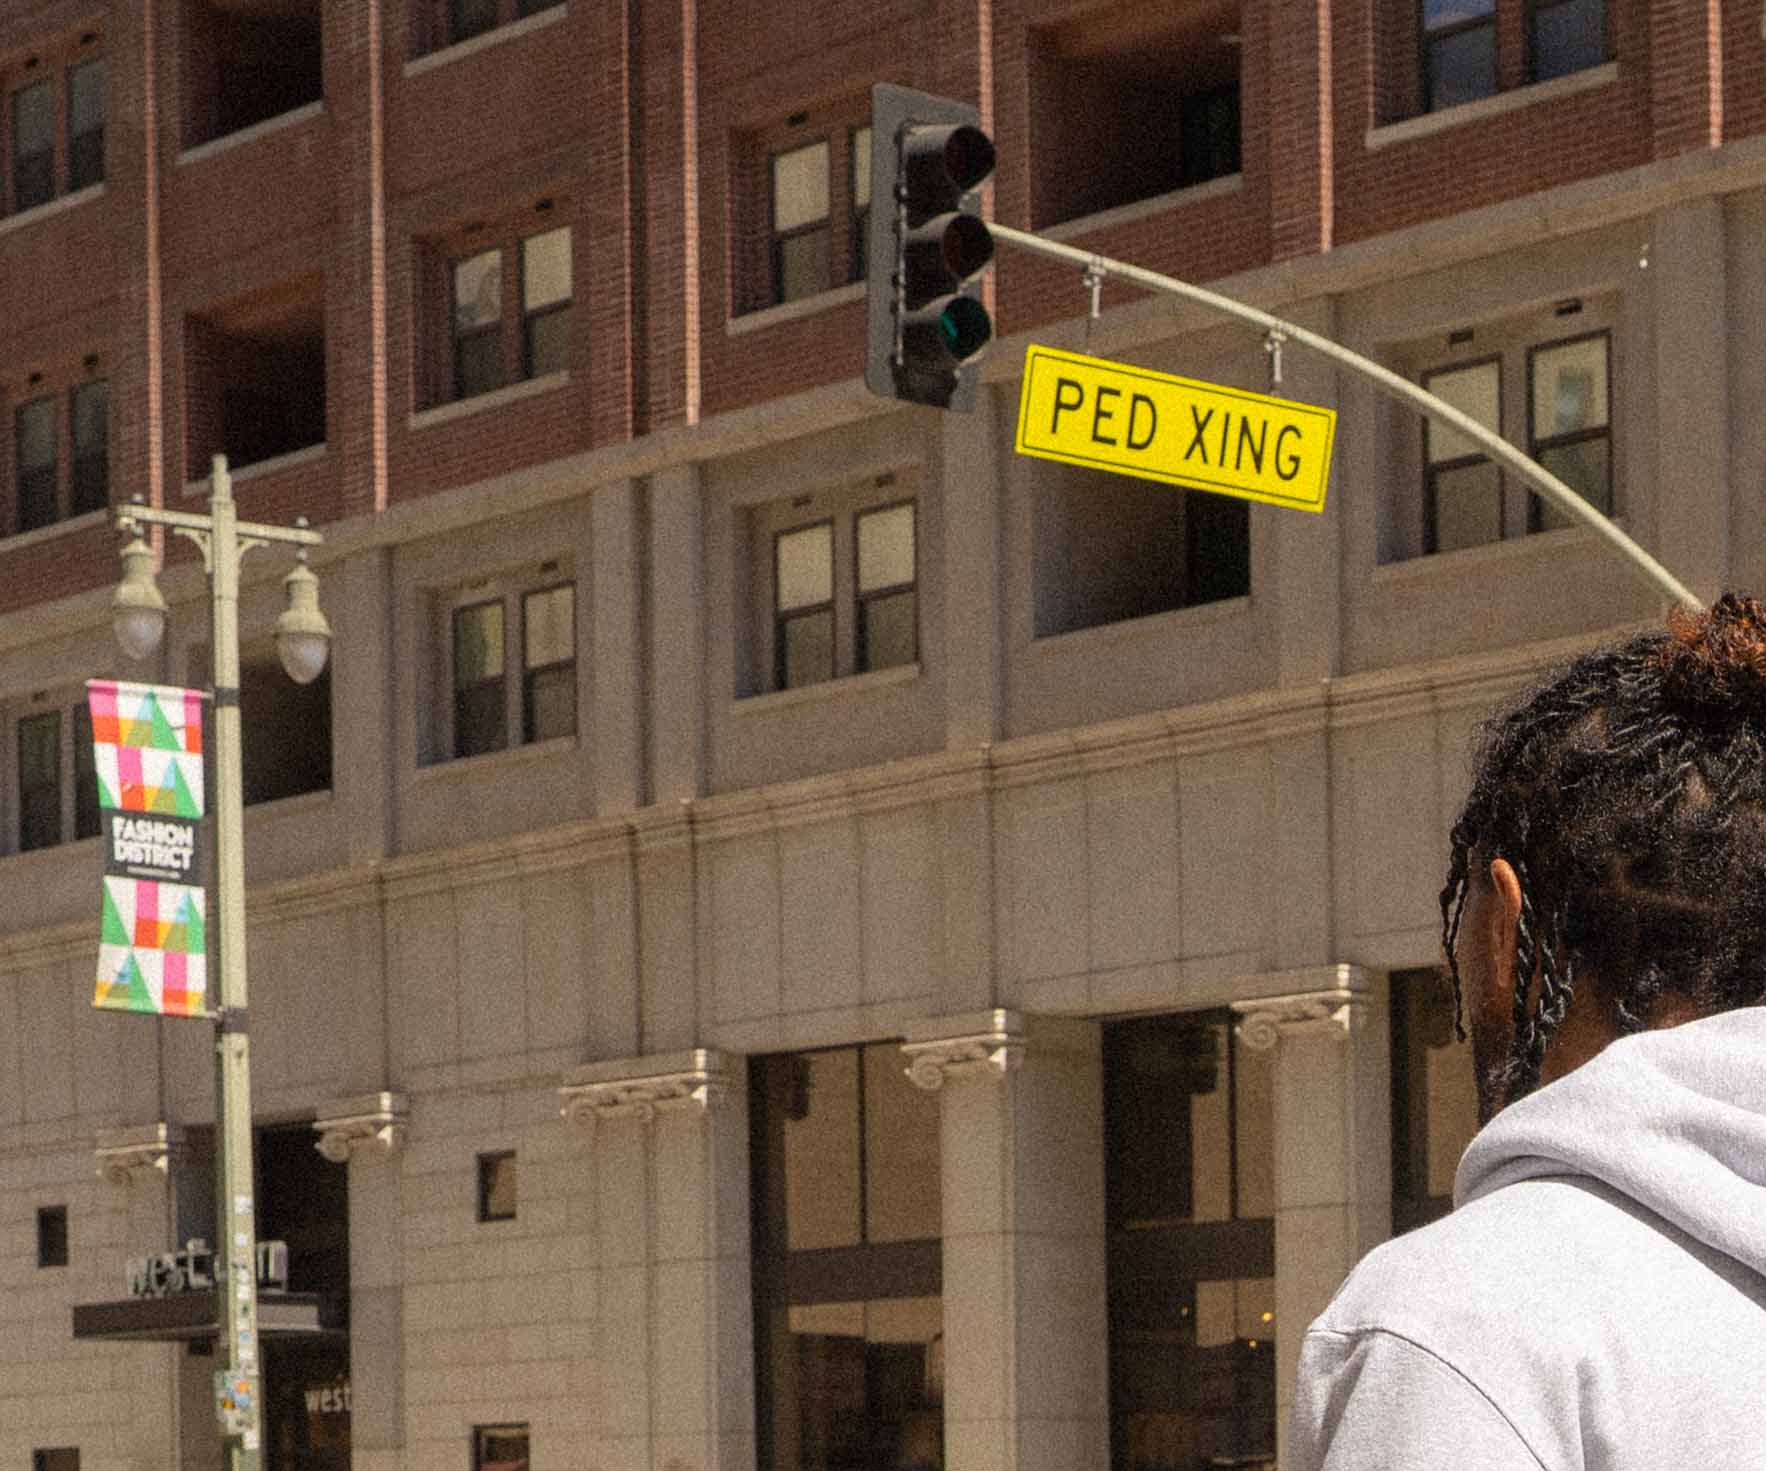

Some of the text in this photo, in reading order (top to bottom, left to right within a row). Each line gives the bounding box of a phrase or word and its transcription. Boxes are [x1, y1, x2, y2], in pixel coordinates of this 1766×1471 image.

[1051, 377, 1303, 481] PED XING
[112, 816, 194, 848] FASHION
[114, 840, 194, 870] DISTRICT
